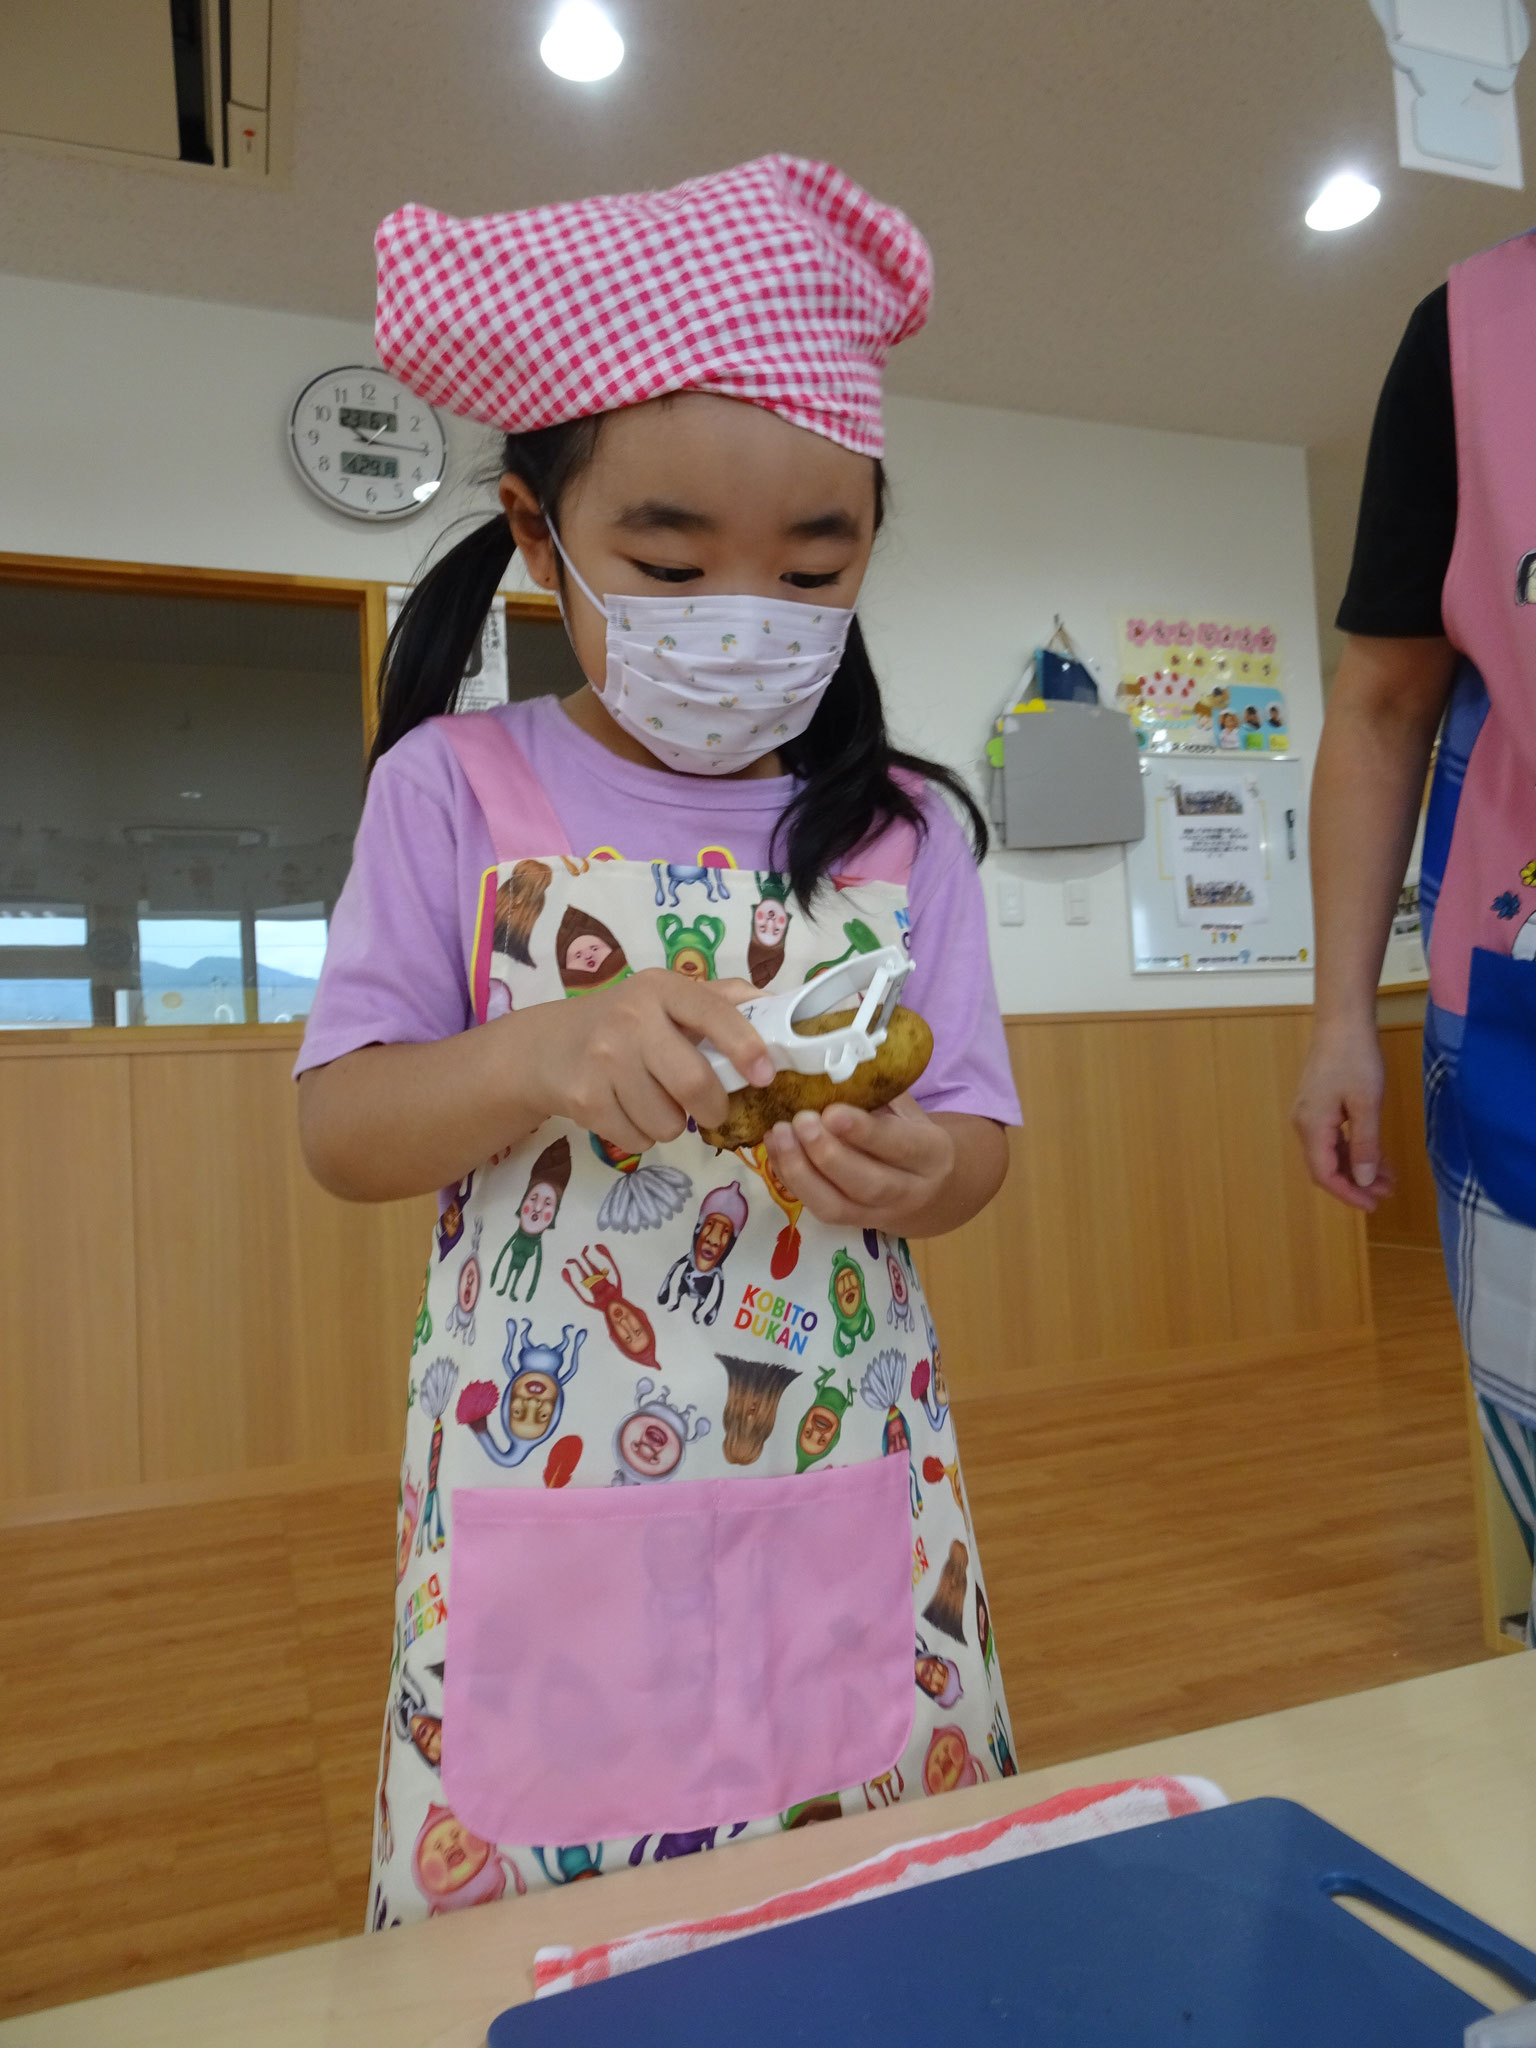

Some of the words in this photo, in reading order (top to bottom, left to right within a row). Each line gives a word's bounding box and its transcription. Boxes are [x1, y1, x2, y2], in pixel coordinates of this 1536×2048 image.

[334, 388, 347, 404] 11
[361, 382, 376, 400] 12
[393, 393, 401, 409] 1
[315, 405, 331, 422] 10
[410, 416, 420, 432] 2
[308, 430, 319, 446] 9
[420, 441, 429, 457] 3
[319, 456, 330, 472] 8
[412, 467, 421, 482] 4
[338, 478, 350, 494] 7
[394, 482, 403, 499] 5
[366, 487, 377, 504] 6
[742, 1284, 817, 1332] KOBITO
[734, 1308, 808, 1355] DUKAN
